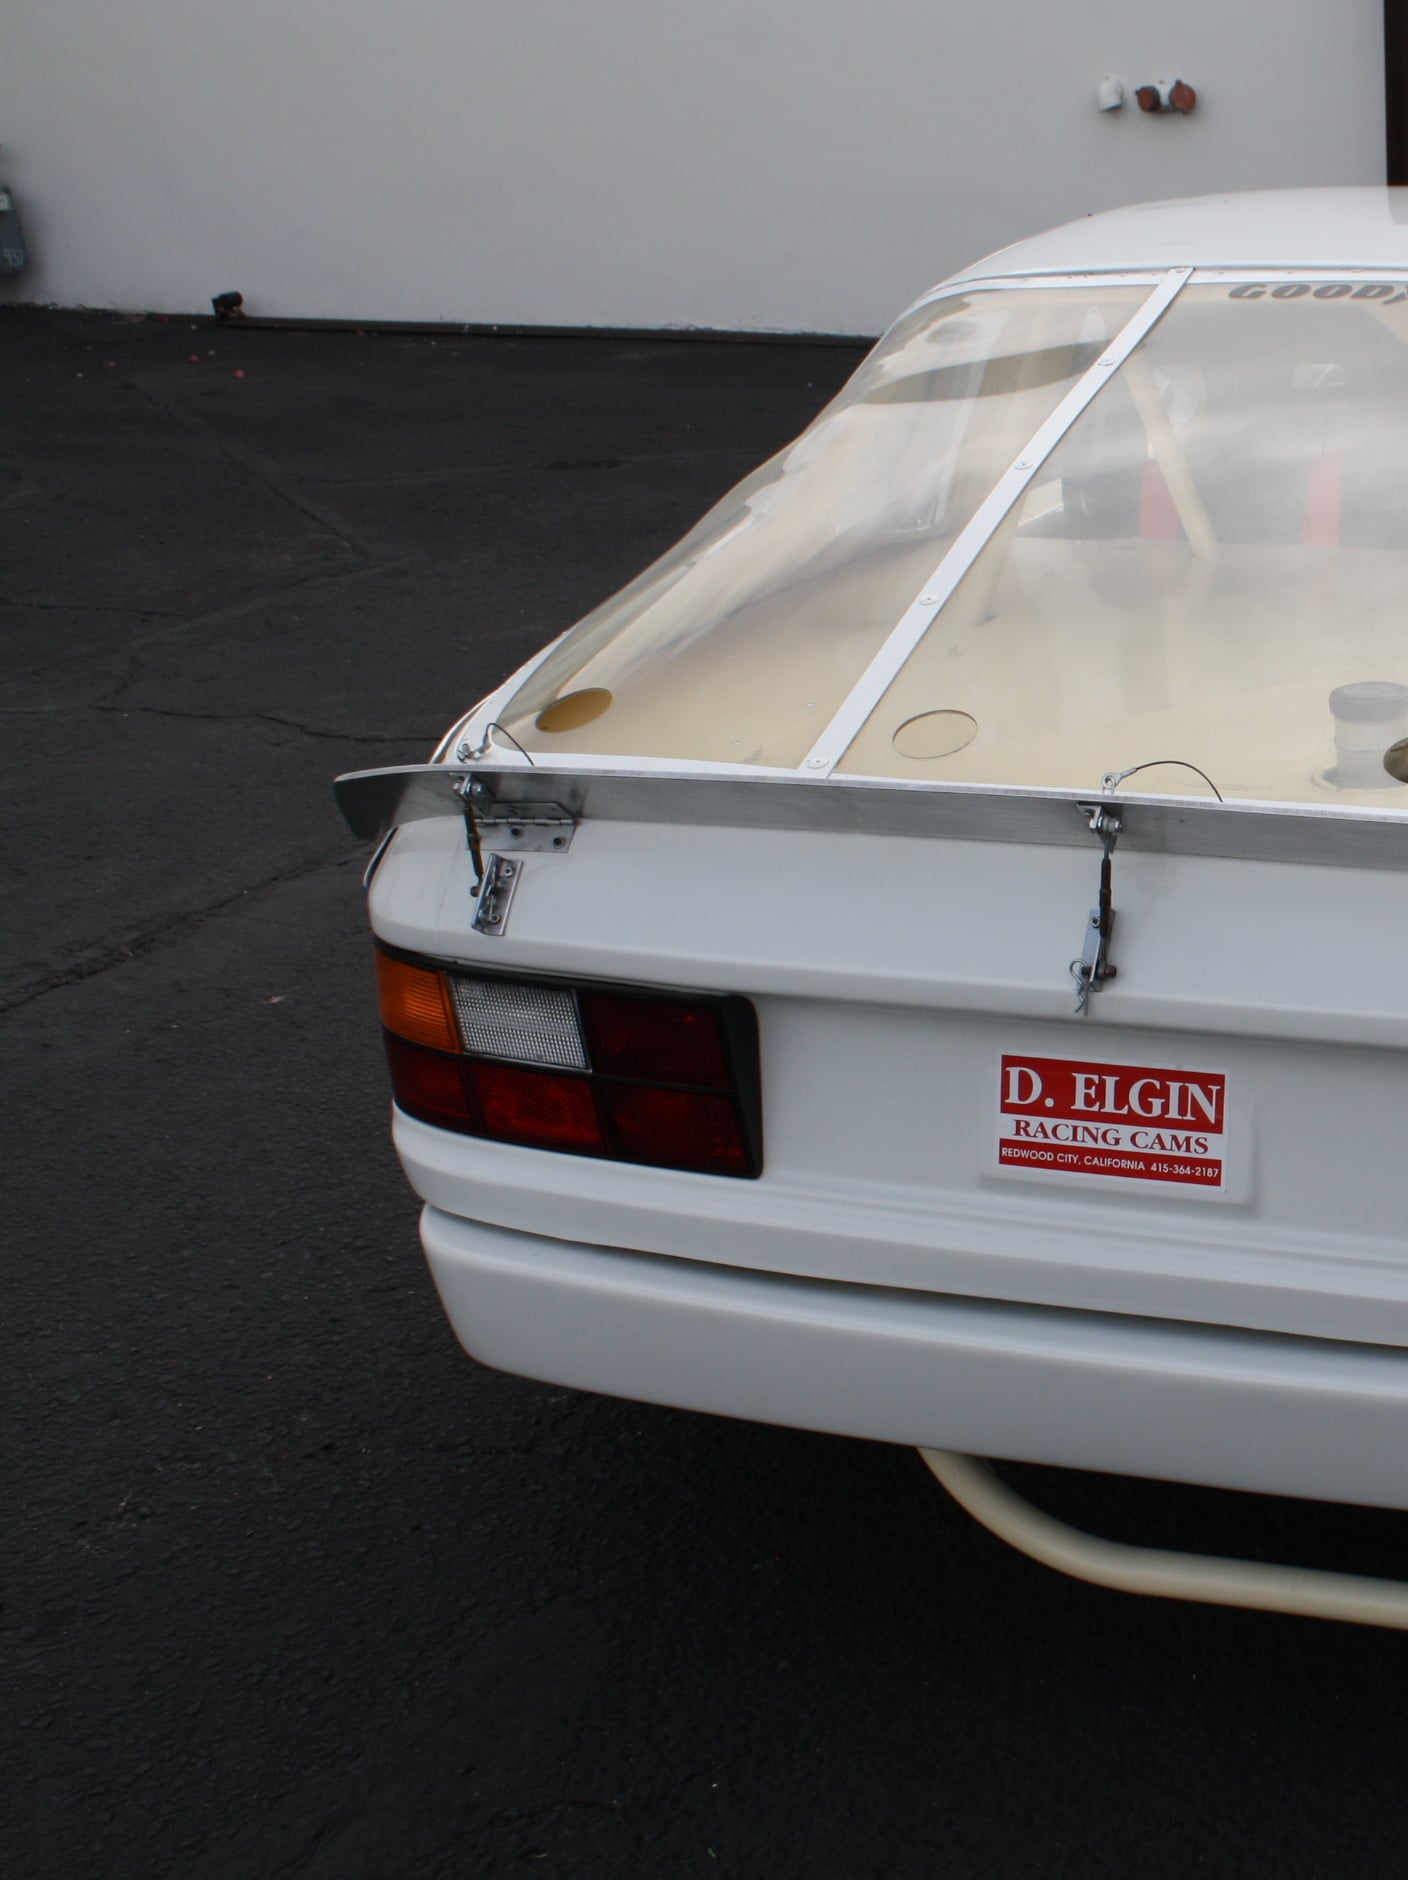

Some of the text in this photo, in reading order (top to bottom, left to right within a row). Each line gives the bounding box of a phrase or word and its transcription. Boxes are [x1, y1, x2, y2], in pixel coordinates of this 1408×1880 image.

[1004, 1066, 1221, 1124] D. ELGIN
[1013, 1119, 1209, 1155] RACING CAMS
[1001, 1147, 1219, 1178] REDWOOD CITY, CALIFORNIA 415-364-2187
